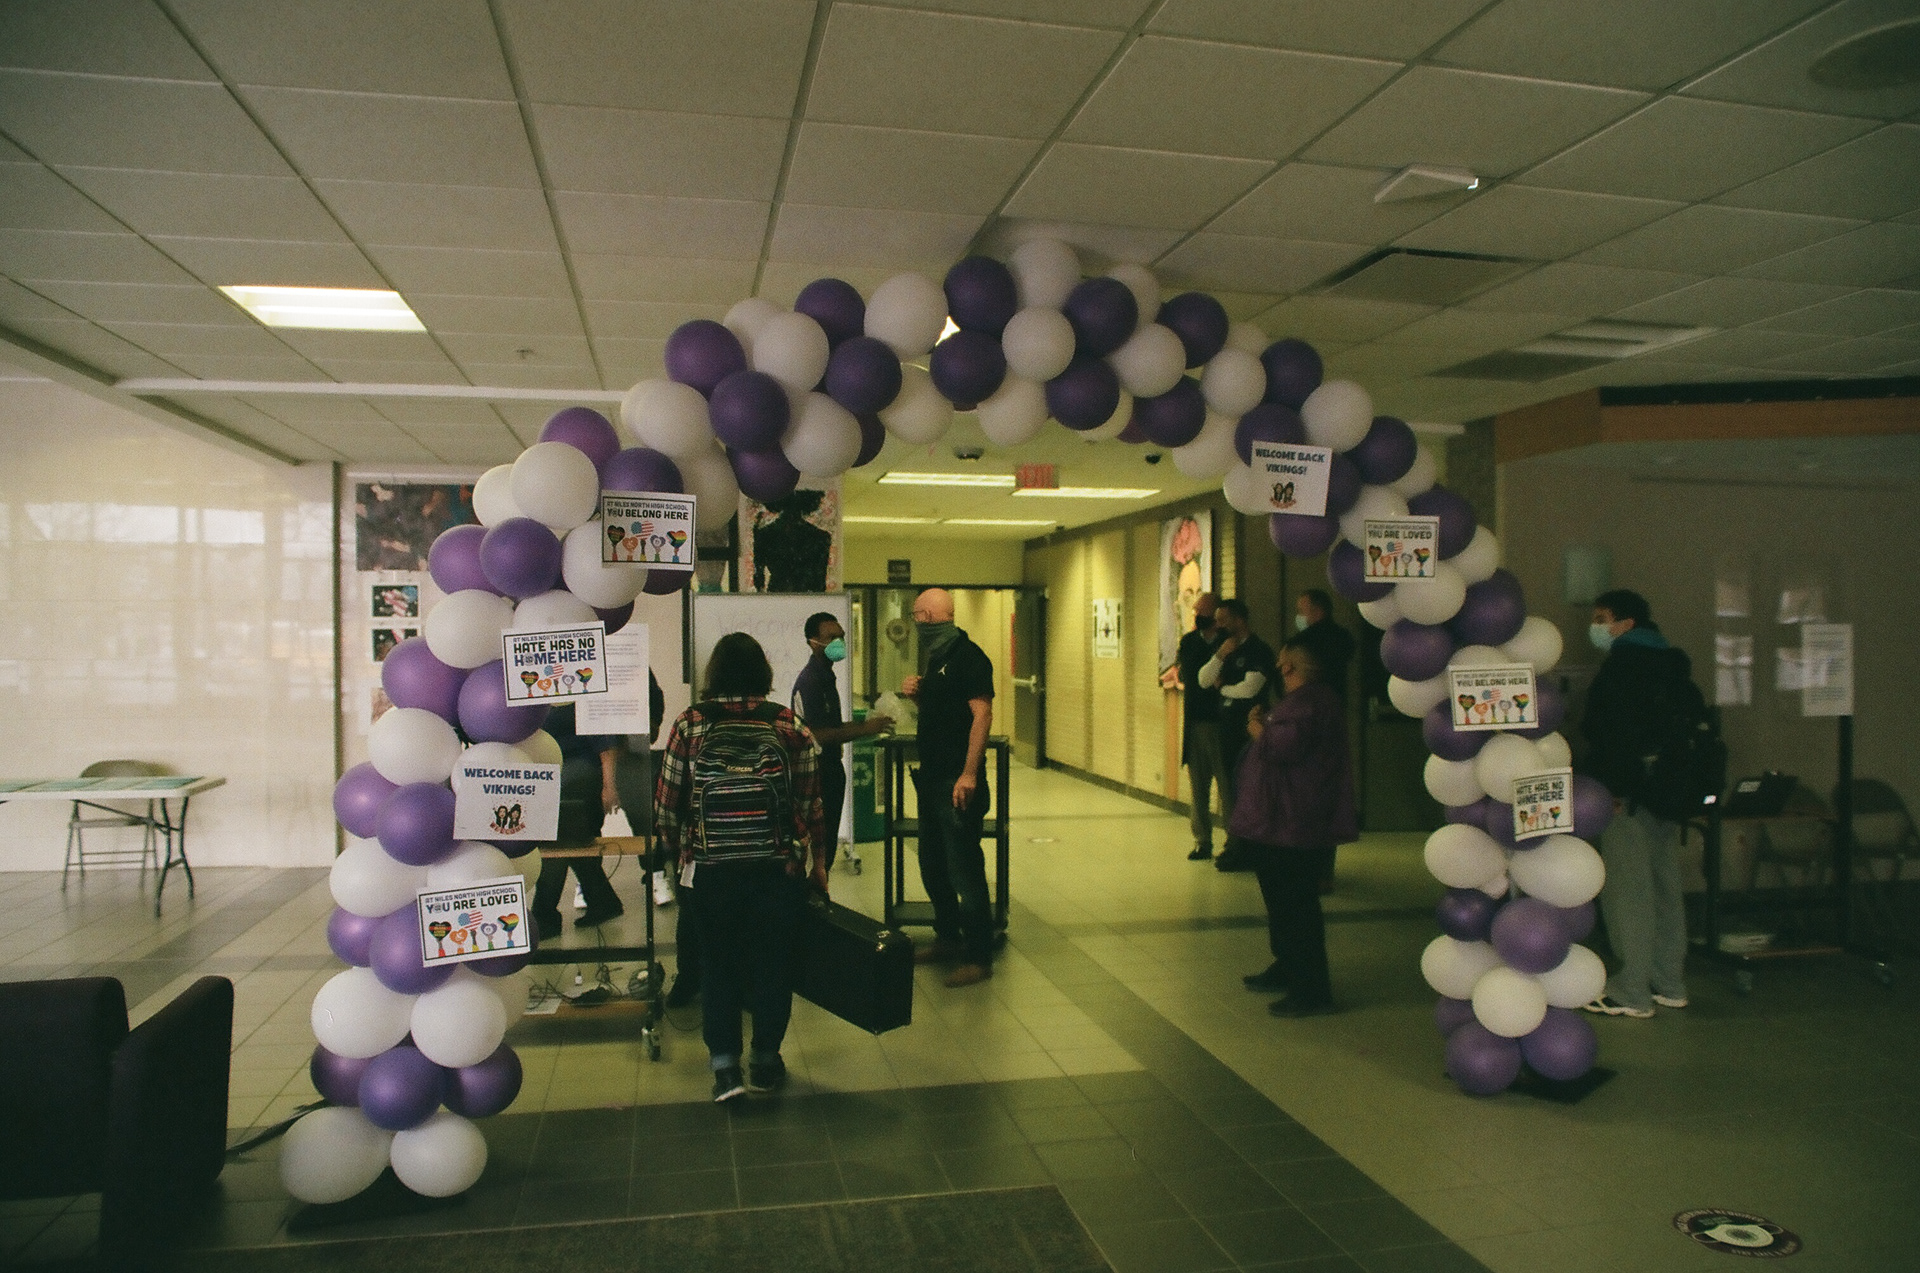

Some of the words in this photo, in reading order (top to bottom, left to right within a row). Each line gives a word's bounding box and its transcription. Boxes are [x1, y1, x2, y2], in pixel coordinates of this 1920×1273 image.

[1255, 448, 1296, 460] WELCOME
[1297, 452, 1325, 463] BACK
[1266, 463, 1308, 475] VIKINGS!
[665, 503, 688, 511] SCHOOL
[625, 508, 662, 519] BELONG
[664, 510, 689, 520] HERE
[1384, 530, 1400, 538] ARE
[1403, 530, 1432, 539] LOVED
[513, 642, 546, 653] HATE
[550, 639, 575, 651] HAS
[578, 637, 595, 648] NO
[558, 648, 597, 663] HERE
[1475, 678, 1506, 687] BELONG
[464, 768, 521, 779] WELCOME
[523, 770, 554, 780] BACK
[483, 784, 536, 796] VIKINGS!
[1551, 781, 1564, 789] NO
[1539, 790, 1564, 801] HERE
[454, 892, 475, 900] NORTH
[476, 890, 491, 898] HIGH
[492, 887, 516, 895] SCHOOL
[453, 899, 477, 911] ARE
[480, 893, 518, 907] LOVED
